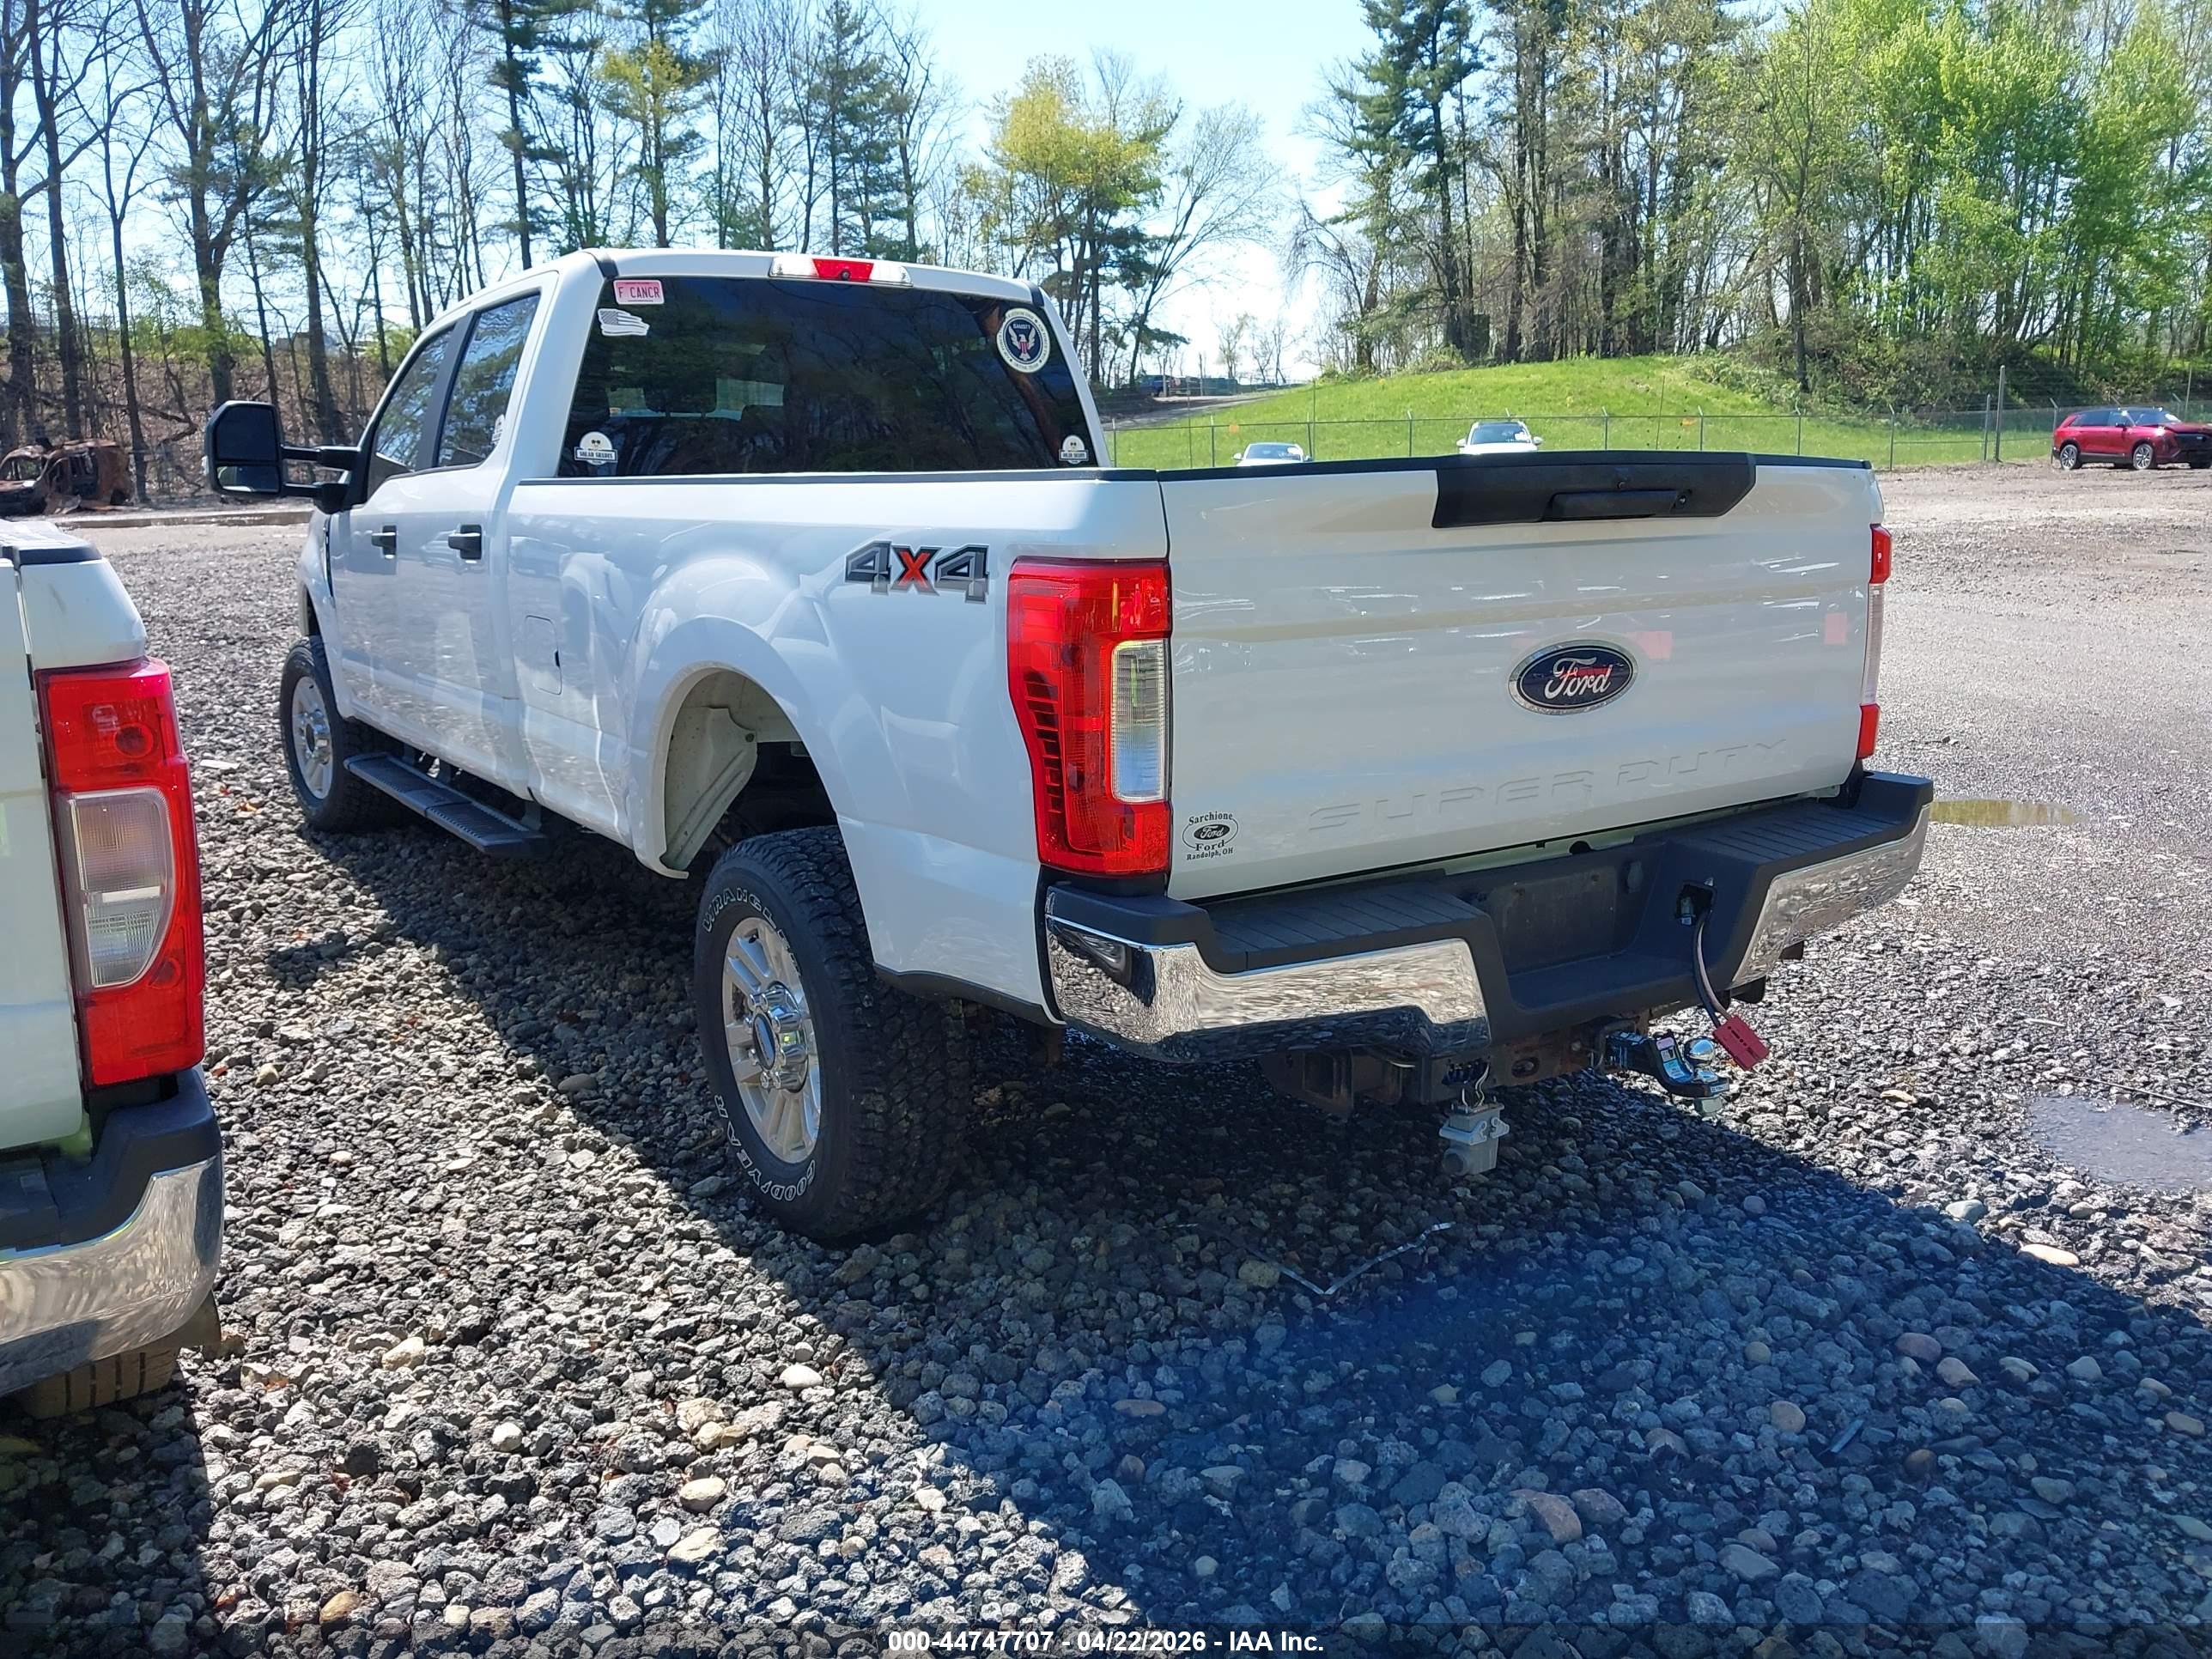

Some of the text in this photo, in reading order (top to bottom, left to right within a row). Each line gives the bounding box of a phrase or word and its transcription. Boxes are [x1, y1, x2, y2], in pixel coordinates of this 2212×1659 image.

[618, 287, 660, 299] F CANCR
[1545, 657, 1613, 700] Ford
[1308, 738, 1787, 831] SUPER DUTY
[1188, 811, 1233, 825] Sarchione
[1200, 825, 1224, 839] Ford
[1195, 840, 1224, 851] Ford
[1187, 849, 1221, 860] Randolph,
[714, 1095, 816, 1201] GOODYEAR
